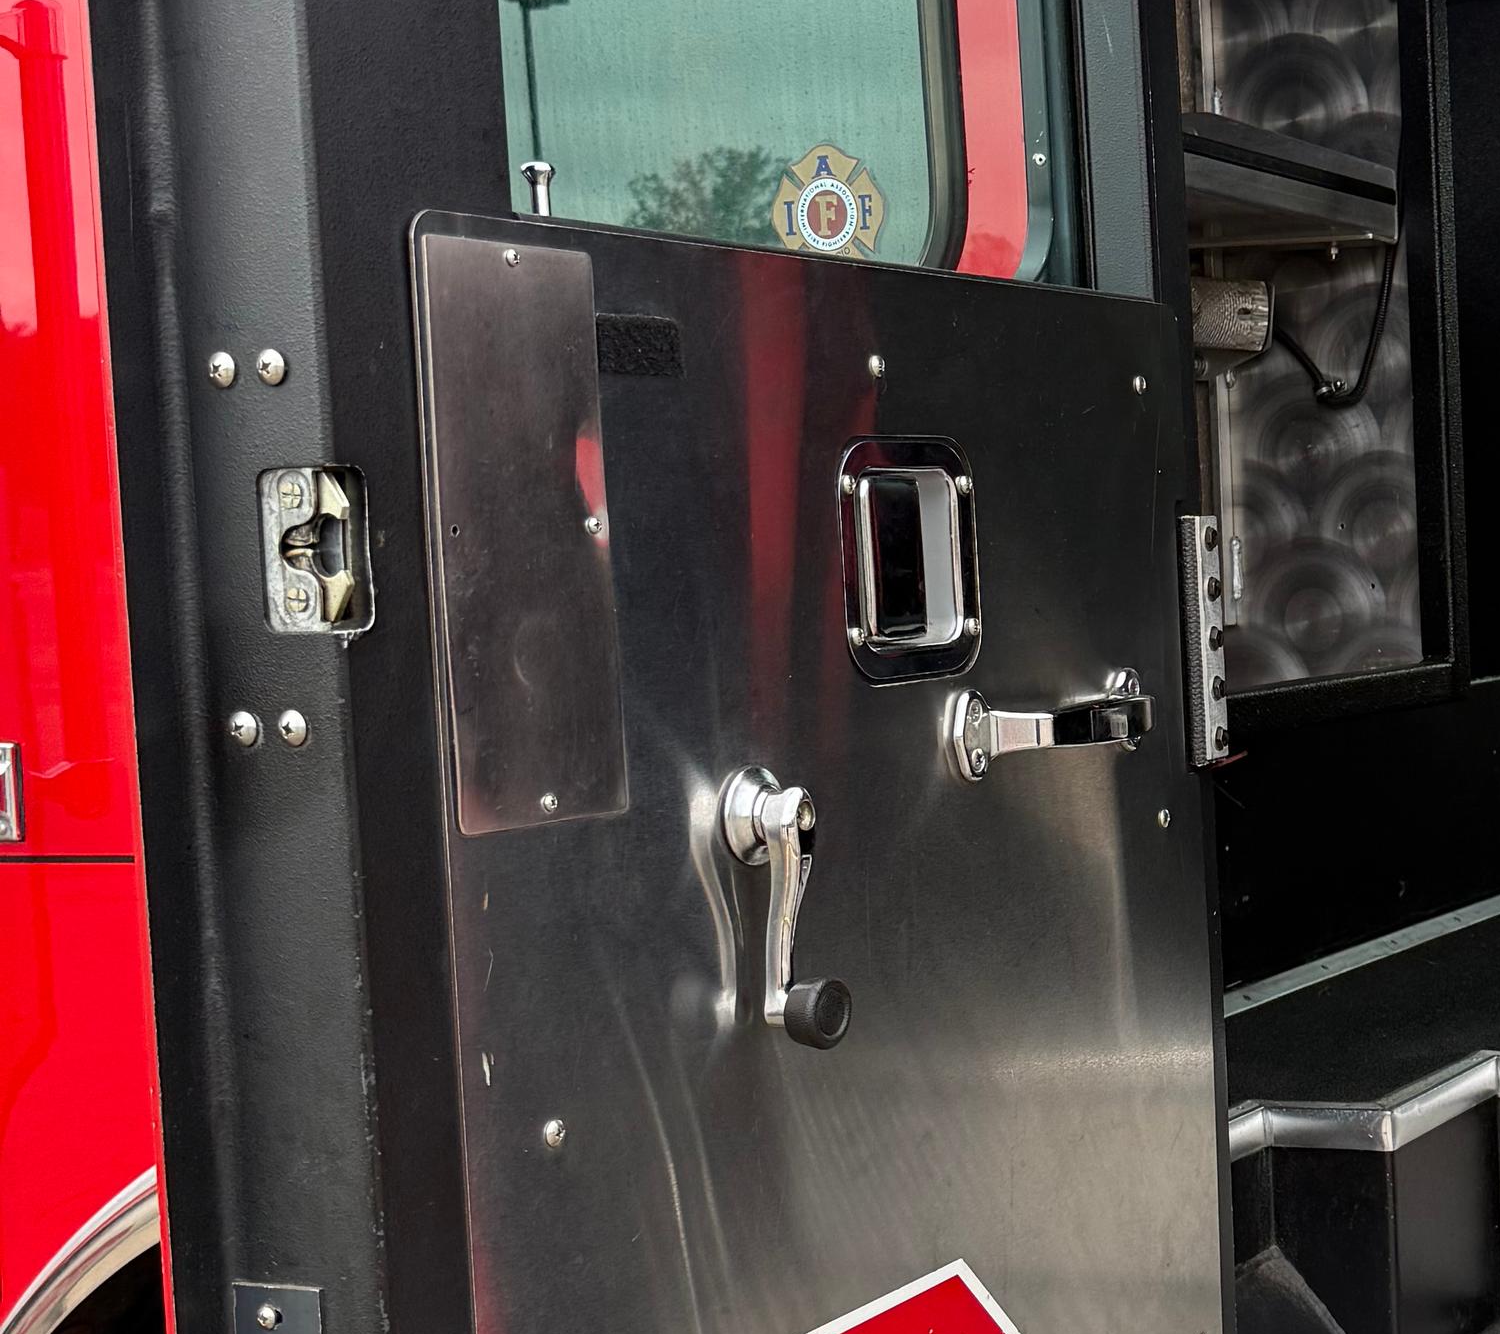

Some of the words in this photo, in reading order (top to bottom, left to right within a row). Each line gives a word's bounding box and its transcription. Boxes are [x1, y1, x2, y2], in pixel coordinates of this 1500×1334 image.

[812, 155, 836, 179] A
[783, 200, 797, 236] I
[814, 194, 838, 236] F
[858, 194, 872, 230] F
